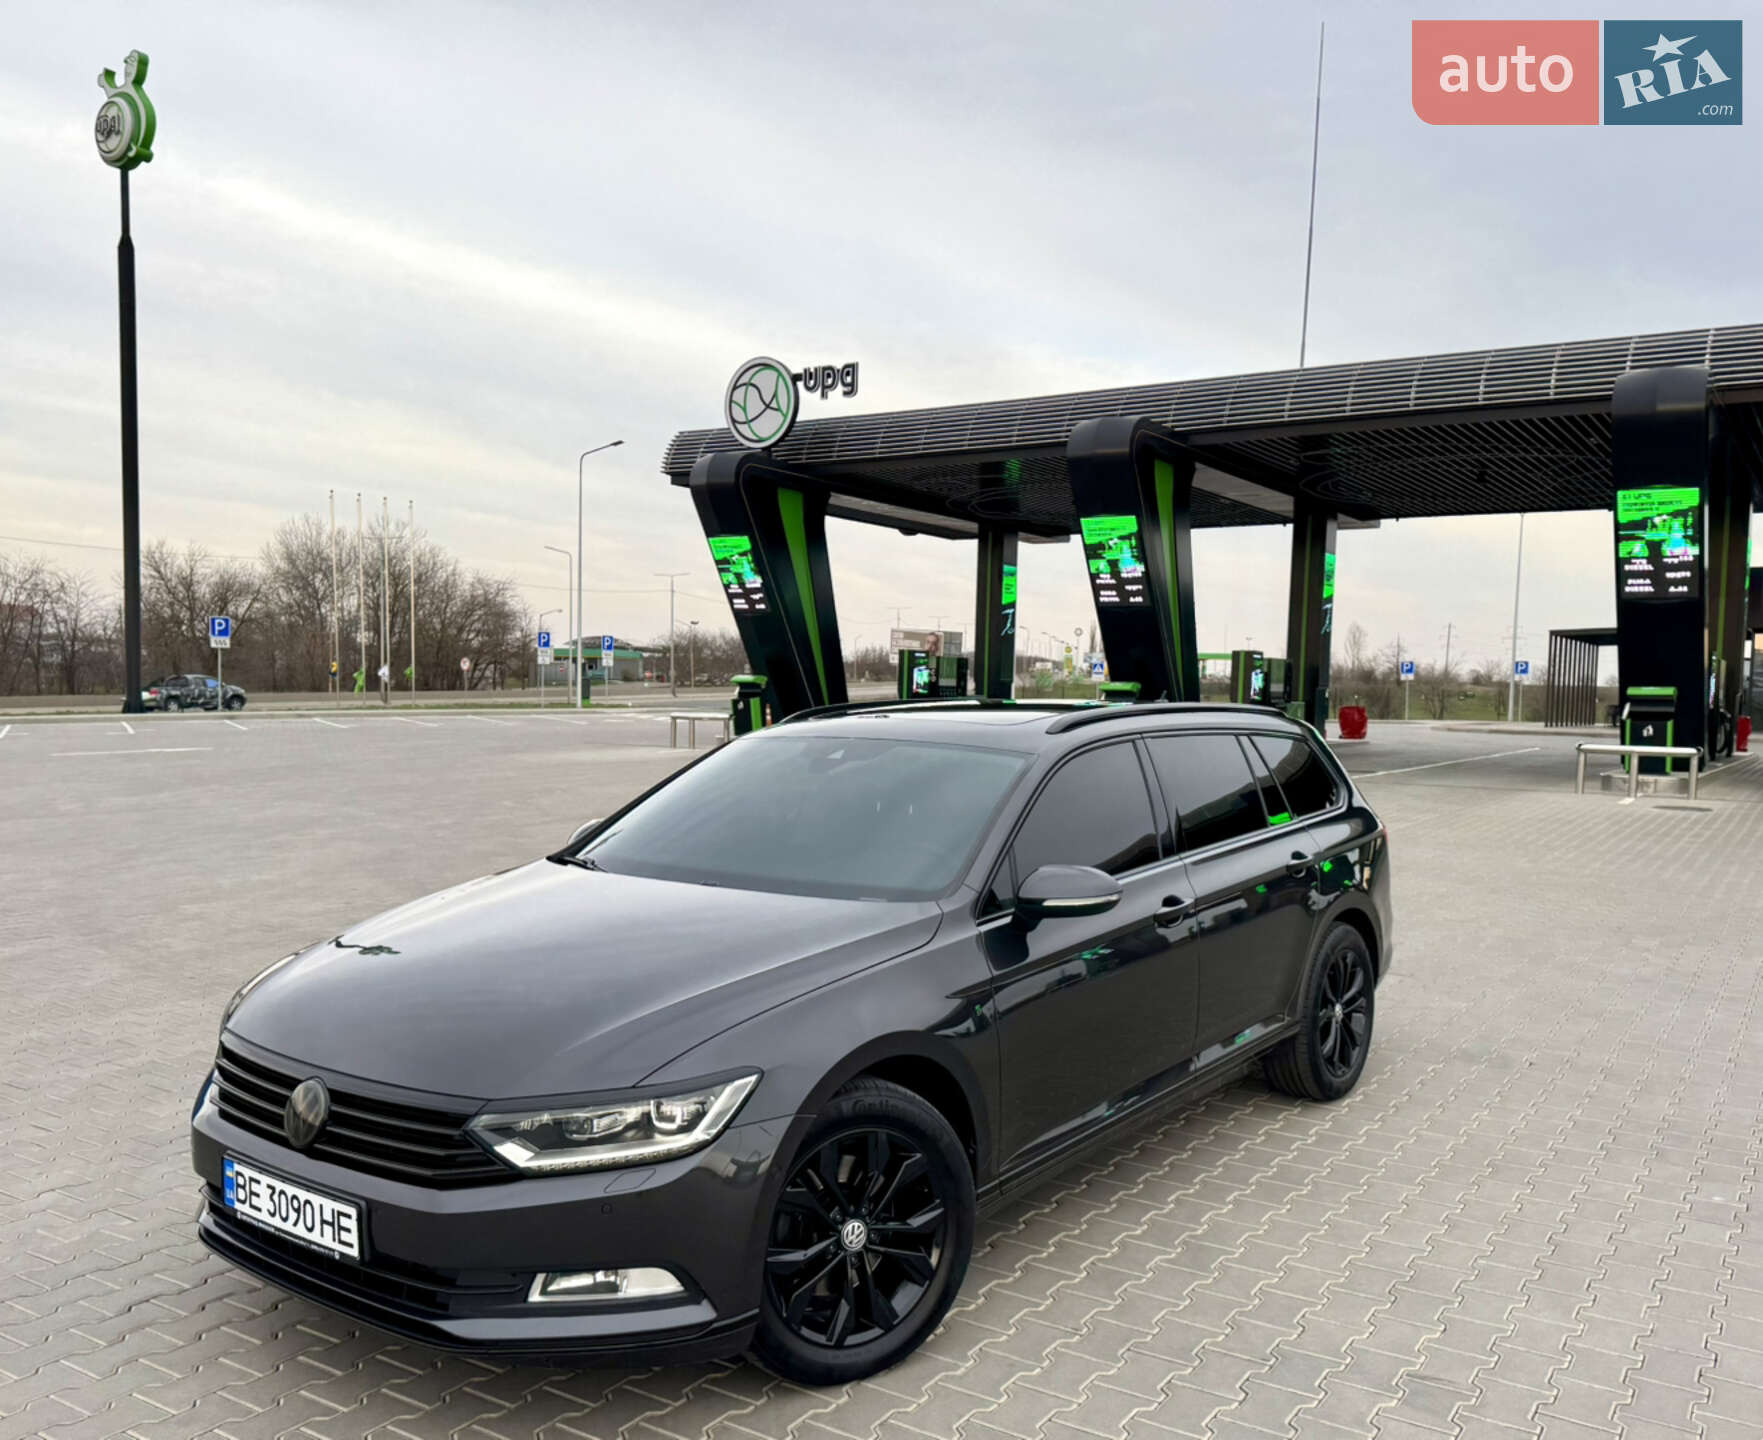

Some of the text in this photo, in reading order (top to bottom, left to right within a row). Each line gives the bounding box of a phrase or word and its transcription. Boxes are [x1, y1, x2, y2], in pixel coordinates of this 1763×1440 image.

[803, 362, 859, 399] upg
[235, 1170, 262, 1213] BE
[266, 1184, 315, 1233] 3090
[319, 1203, 354, 1249] HE
